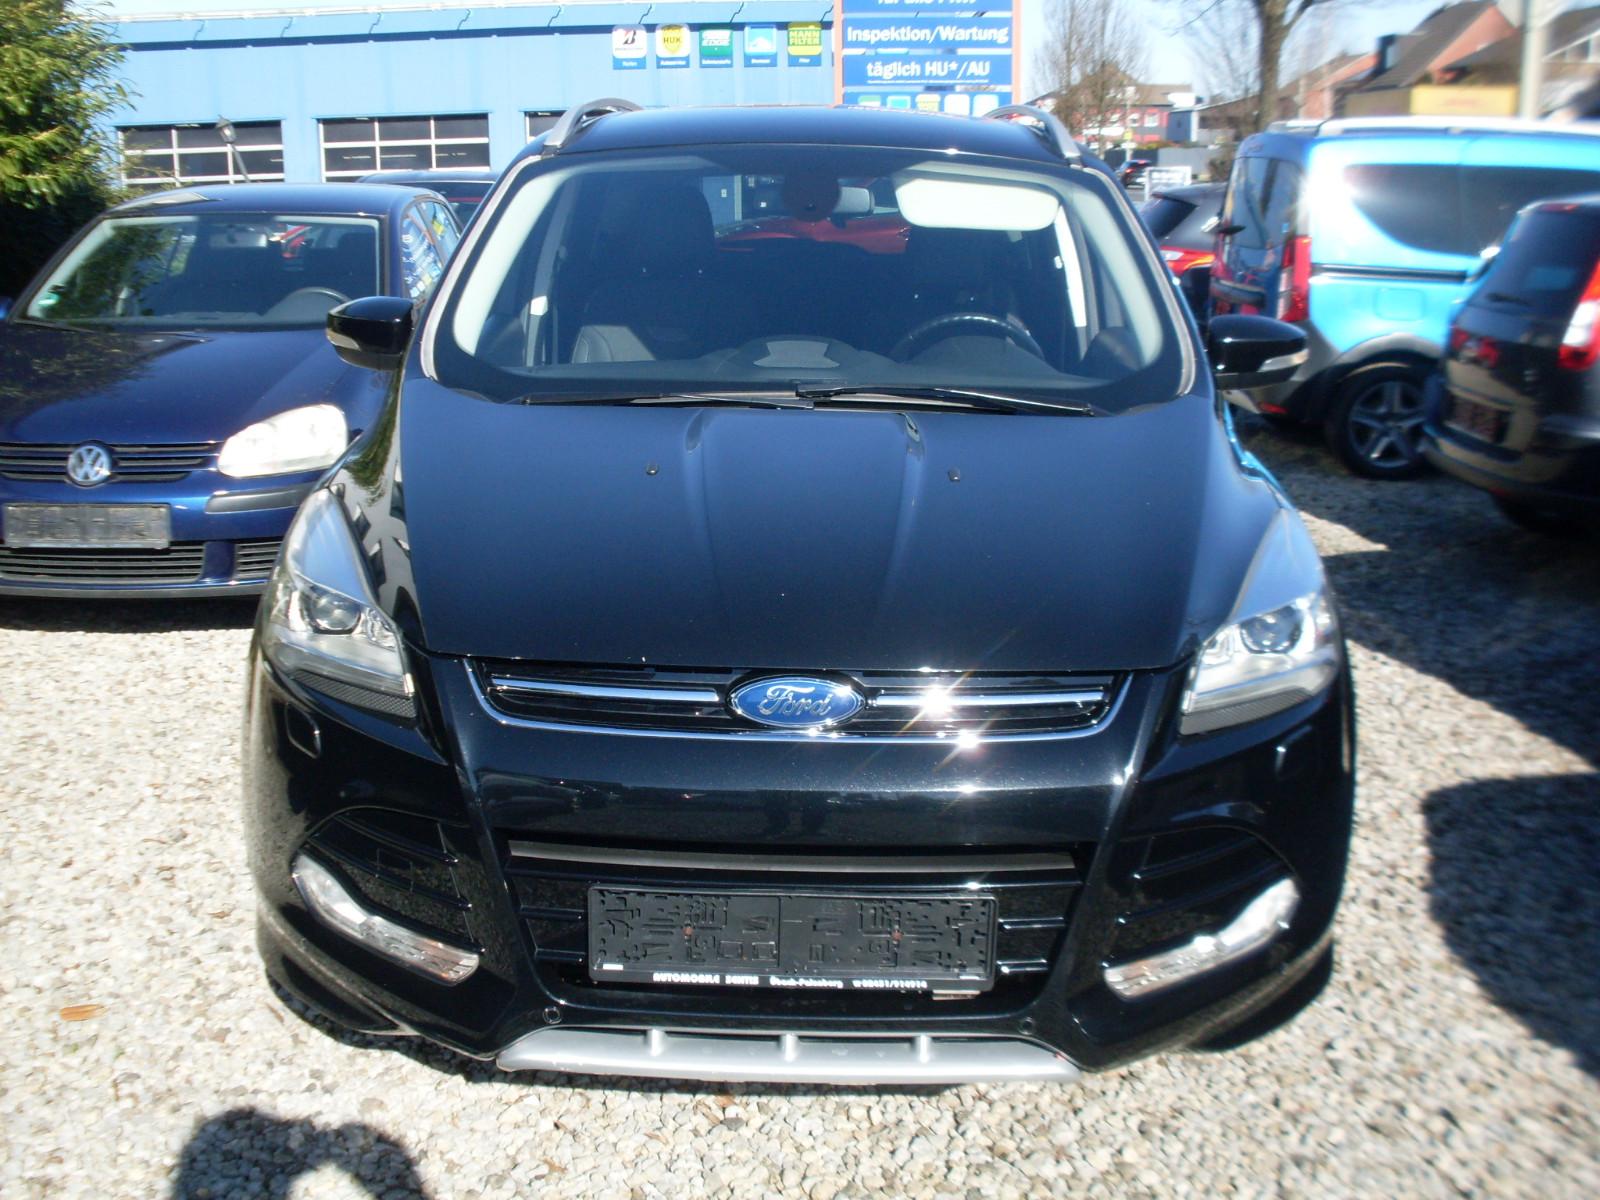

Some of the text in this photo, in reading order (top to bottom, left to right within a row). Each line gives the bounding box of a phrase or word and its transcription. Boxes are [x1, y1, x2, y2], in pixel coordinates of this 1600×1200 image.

[789, 30, 820, 38] MANN
[789, 38, 820, 46] FILTER
[847, 26, 1009, 44] Inspektion/Wartung
[866, 61, 921, 79] täglich
[759, 685, 833, 715] Ford
